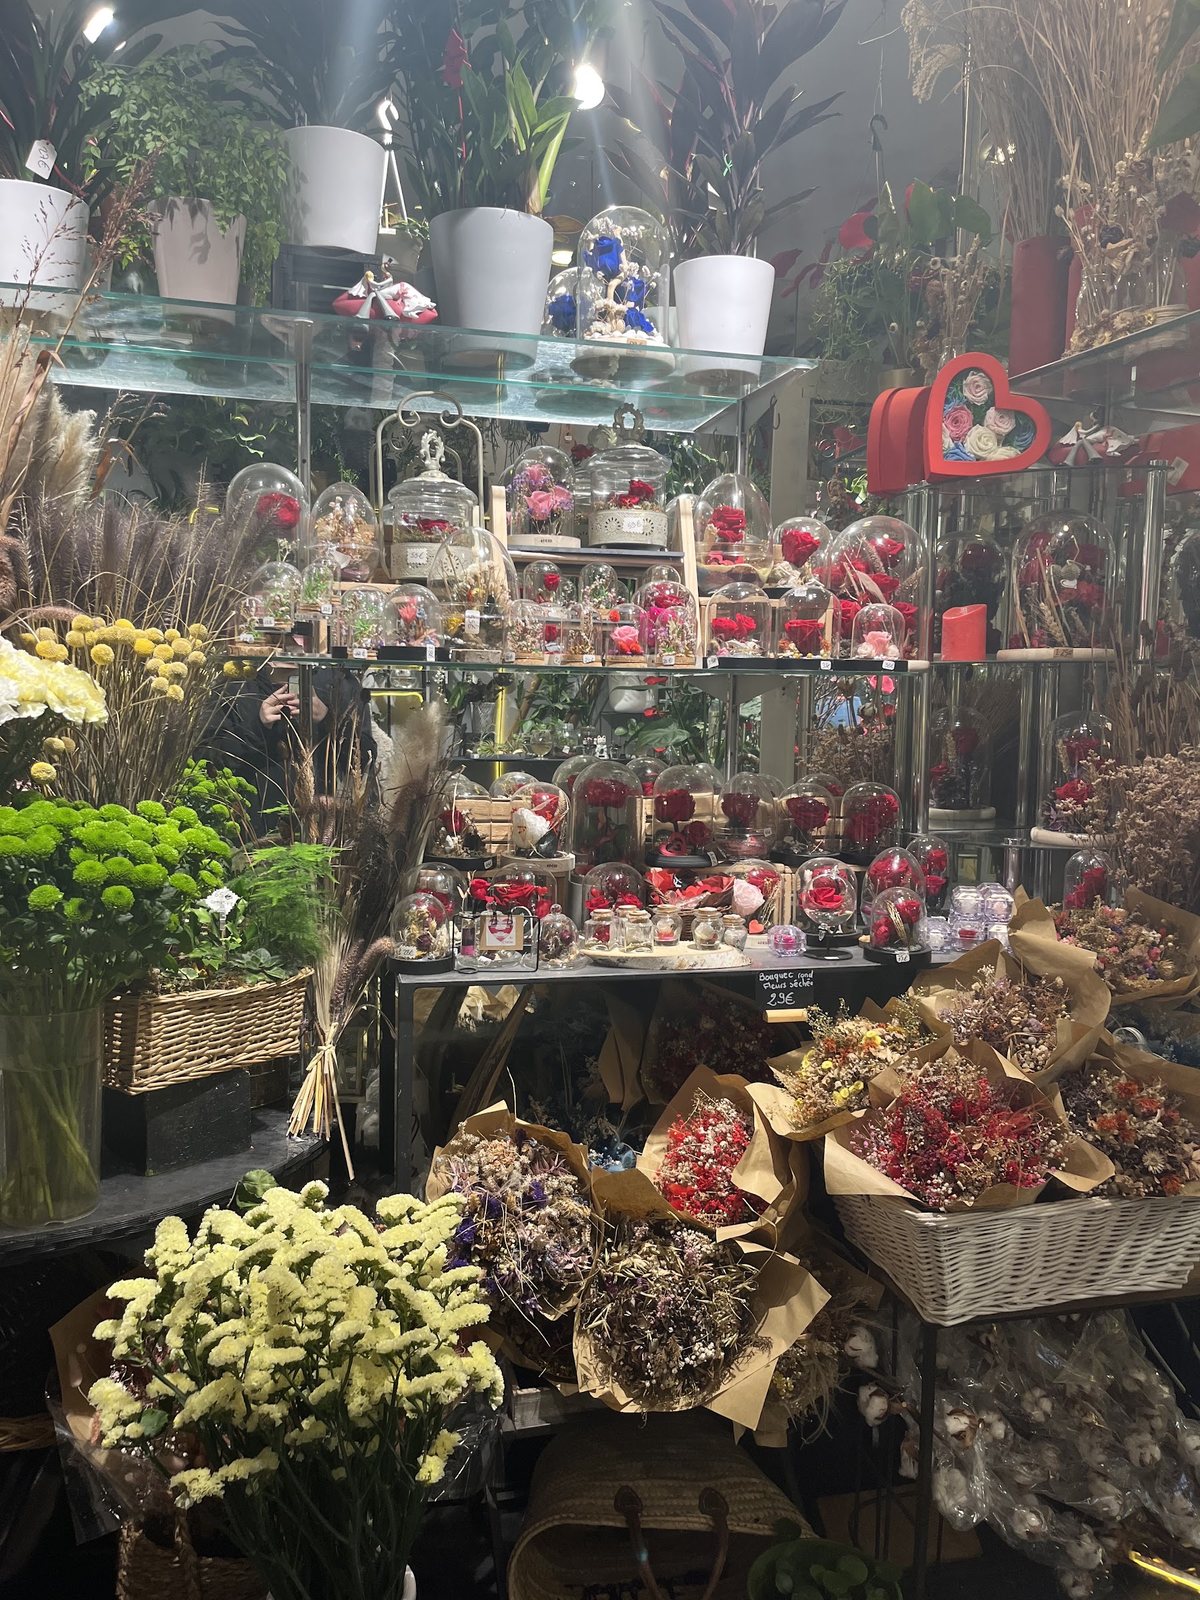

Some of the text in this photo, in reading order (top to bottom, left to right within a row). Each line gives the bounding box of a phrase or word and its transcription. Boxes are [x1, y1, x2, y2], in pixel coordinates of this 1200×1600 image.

[759, 970, 814, 982] Bouquet rond
[766, 991, 796, 1007] 29€
